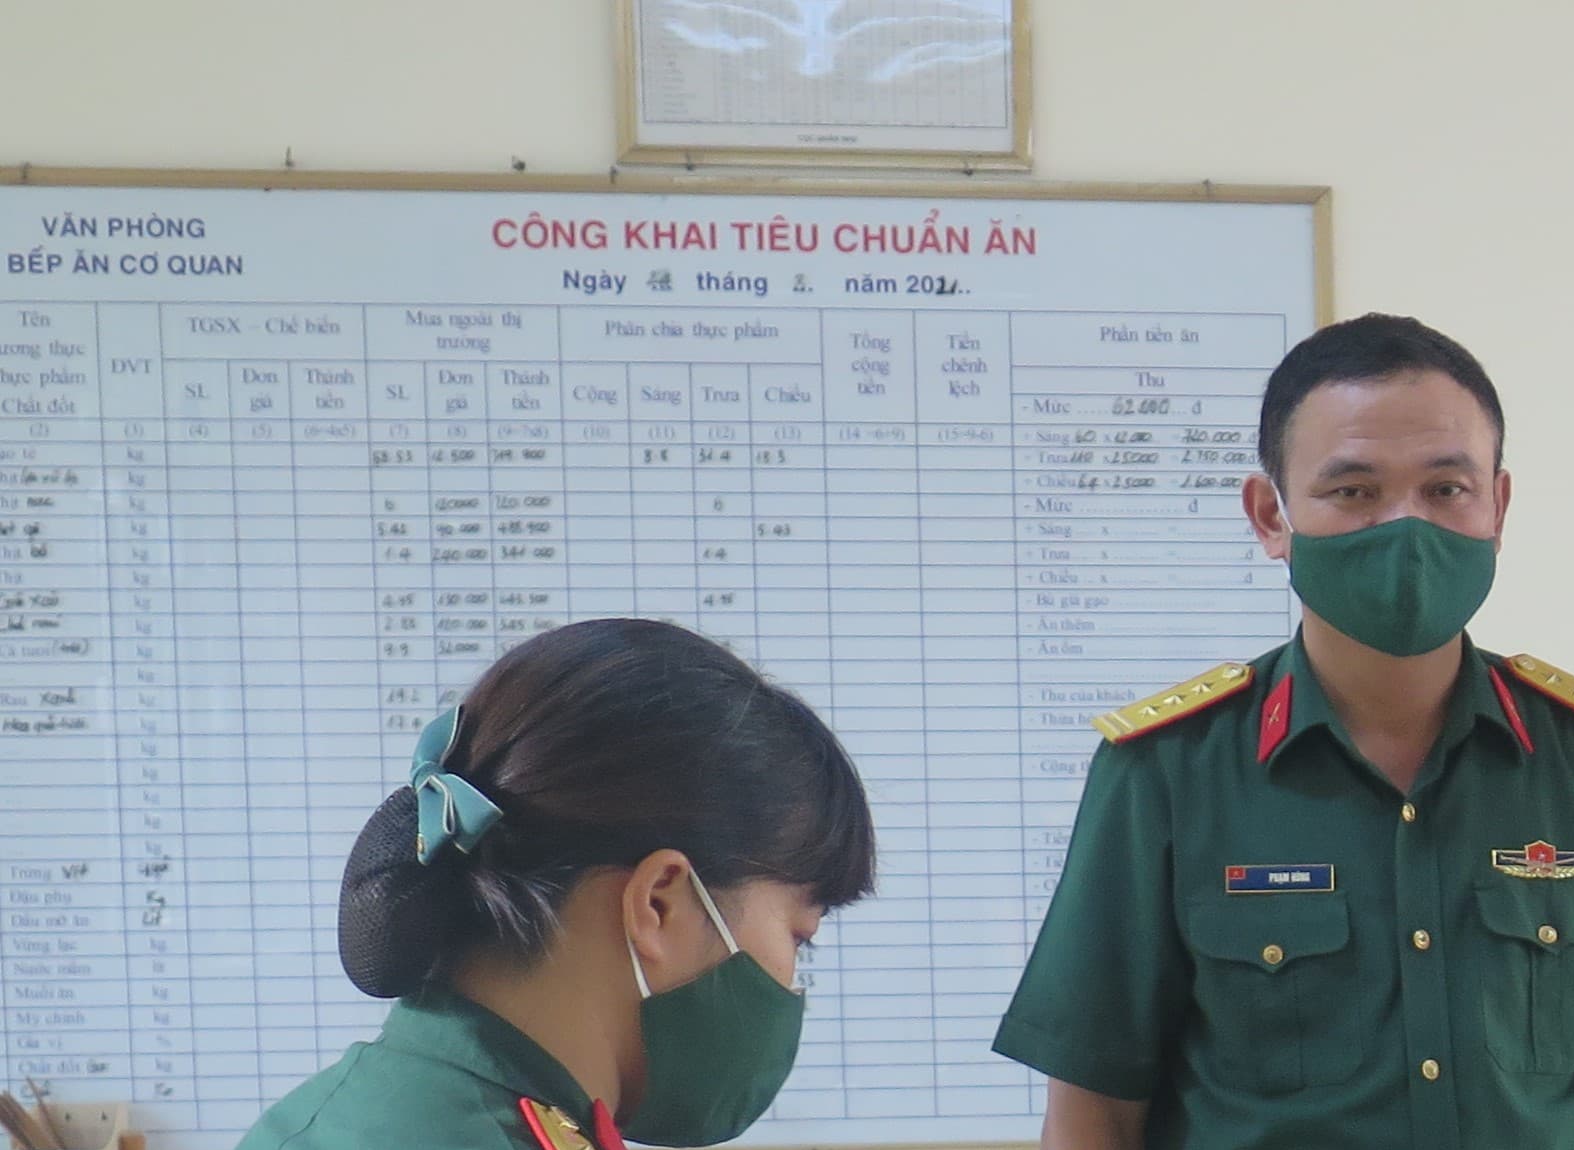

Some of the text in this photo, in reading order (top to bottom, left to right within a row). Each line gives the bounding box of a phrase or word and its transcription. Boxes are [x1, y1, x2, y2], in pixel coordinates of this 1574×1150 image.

[42, 212, 205, 238] VĂN PHÒNG
[492, 209, 1036, 255] CÔNG KHAI TIÊU CHUẨN ĂN
[8, 246, 243, 275] BẾP ĂN CƠ QUAN
[562, 269, 627, 294] Ngày
[696, 270, 768, 296] tháng
[844, 274, 896, 293] năm
[18, 310, 51, 328] Tên
[188, 314, 341, 335] TGSX Chế biến
[405, 310, 522, 329] Mua ngoài thị
[652, 320, 683, 337] chia
[693, 321, 728, 338] thực
[734, 318, 779, 341] phẩm
[1100, 325, 1199, 343] Phần tiền ăn
[436, 333, 491, 352] trường
[851, 331, 891, 351] Tổng
[947, 330, 980, 350] Tiền
[852, 357, 889, 376] cộng
[941, 357, 987, 374] chênh
[242, 368, 278, 385] Đơn
[306, 368, 354, 386] Thành
[439, 370, 473, 385] Đơn
[502, 369, 550, 386] Thành
[1136, 372, 1164, 388] Thu
[185, 384, 208, 400] SL
[386, 385, 408, 400] SL
[573, 385, 617, 405] Cộng
[641, 384, 681, 404] Sáng
[703, 386, 740, 402] Trưa
[764, 383, 811, 402] Chiều
[857, 378, 885, 396] tiền
[949, 379, 980, 397] lệch
[512, 390, 540, 409] tiền
[1033, 399, 1070, 414] Mức
[1035, 498, 1072, 512] Mức
[1040, 757, 1075, 775] Cộng
